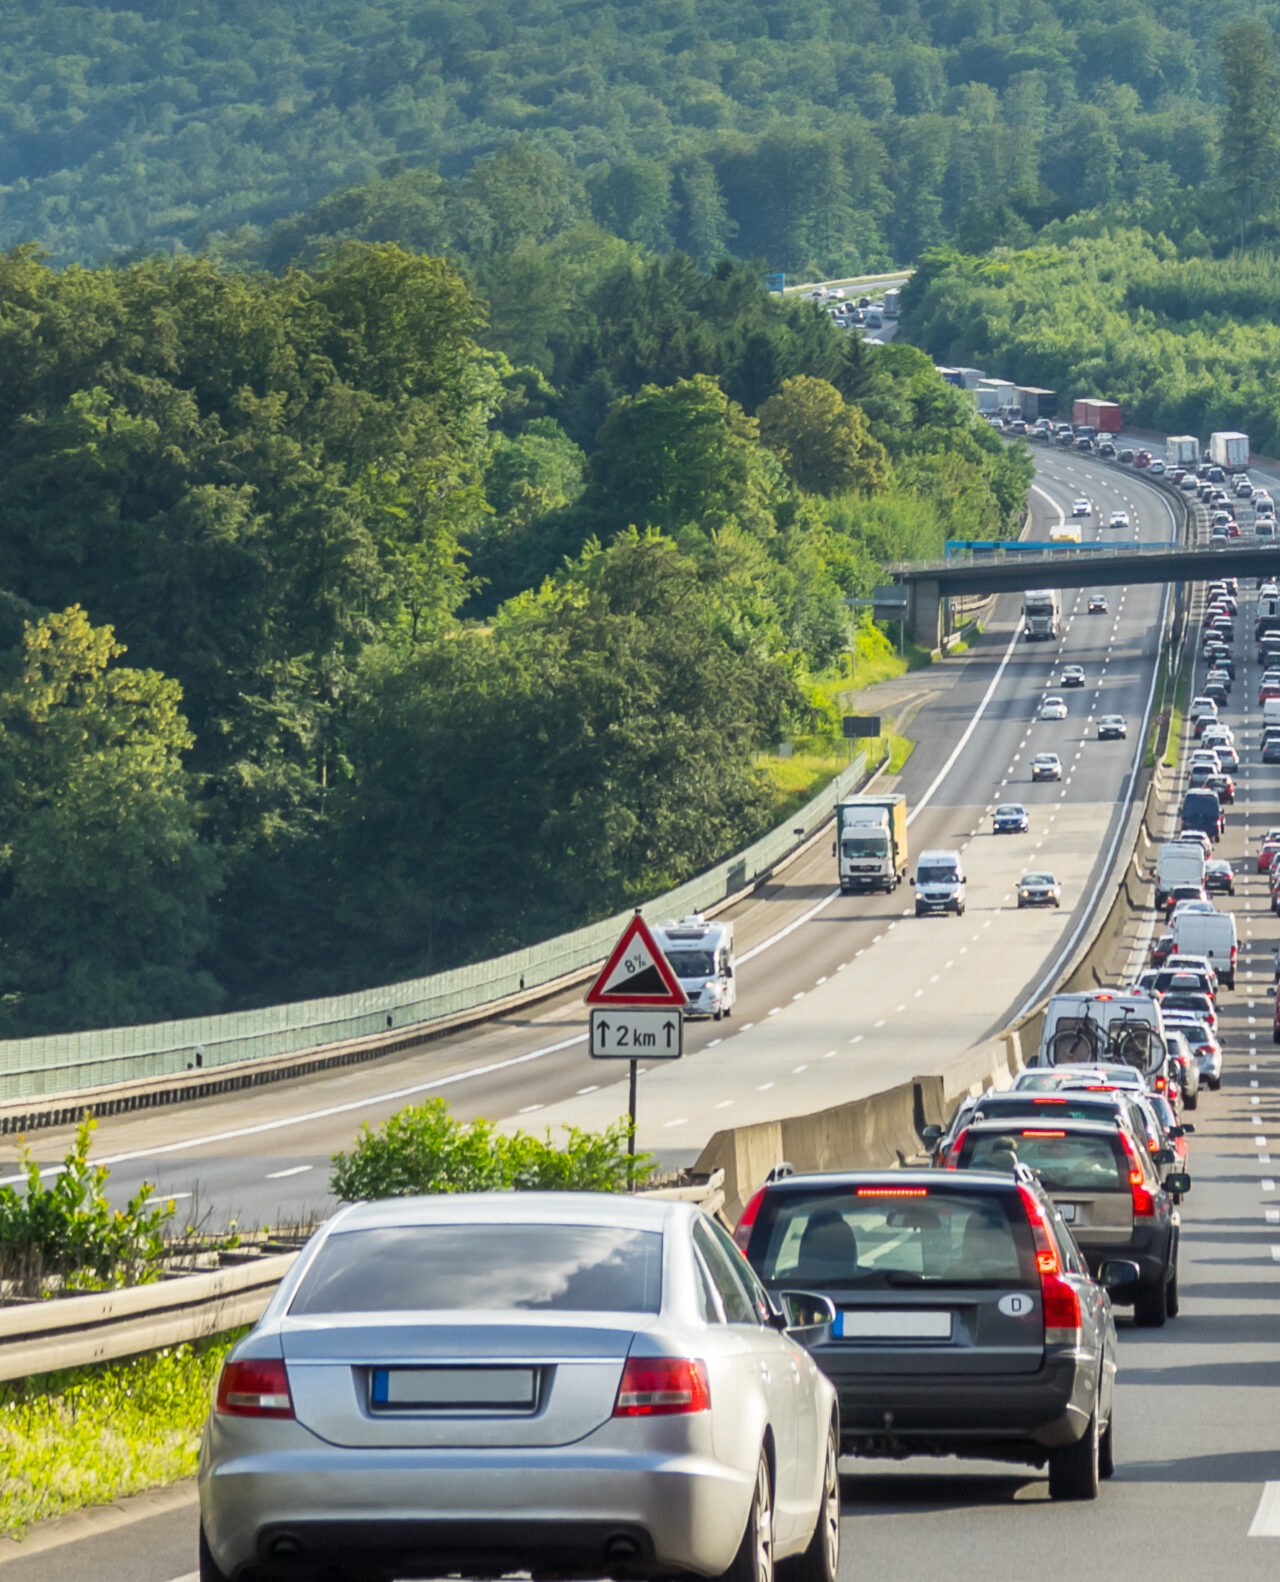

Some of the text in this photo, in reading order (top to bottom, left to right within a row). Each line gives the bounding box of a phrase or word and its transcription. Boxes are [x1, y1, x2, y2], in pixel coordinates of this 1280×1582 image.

[624, 954, 646, 973] 8%
[616, 1025, 656, 1046] 2 km
[1011, 1298, 1022, 1312] D
